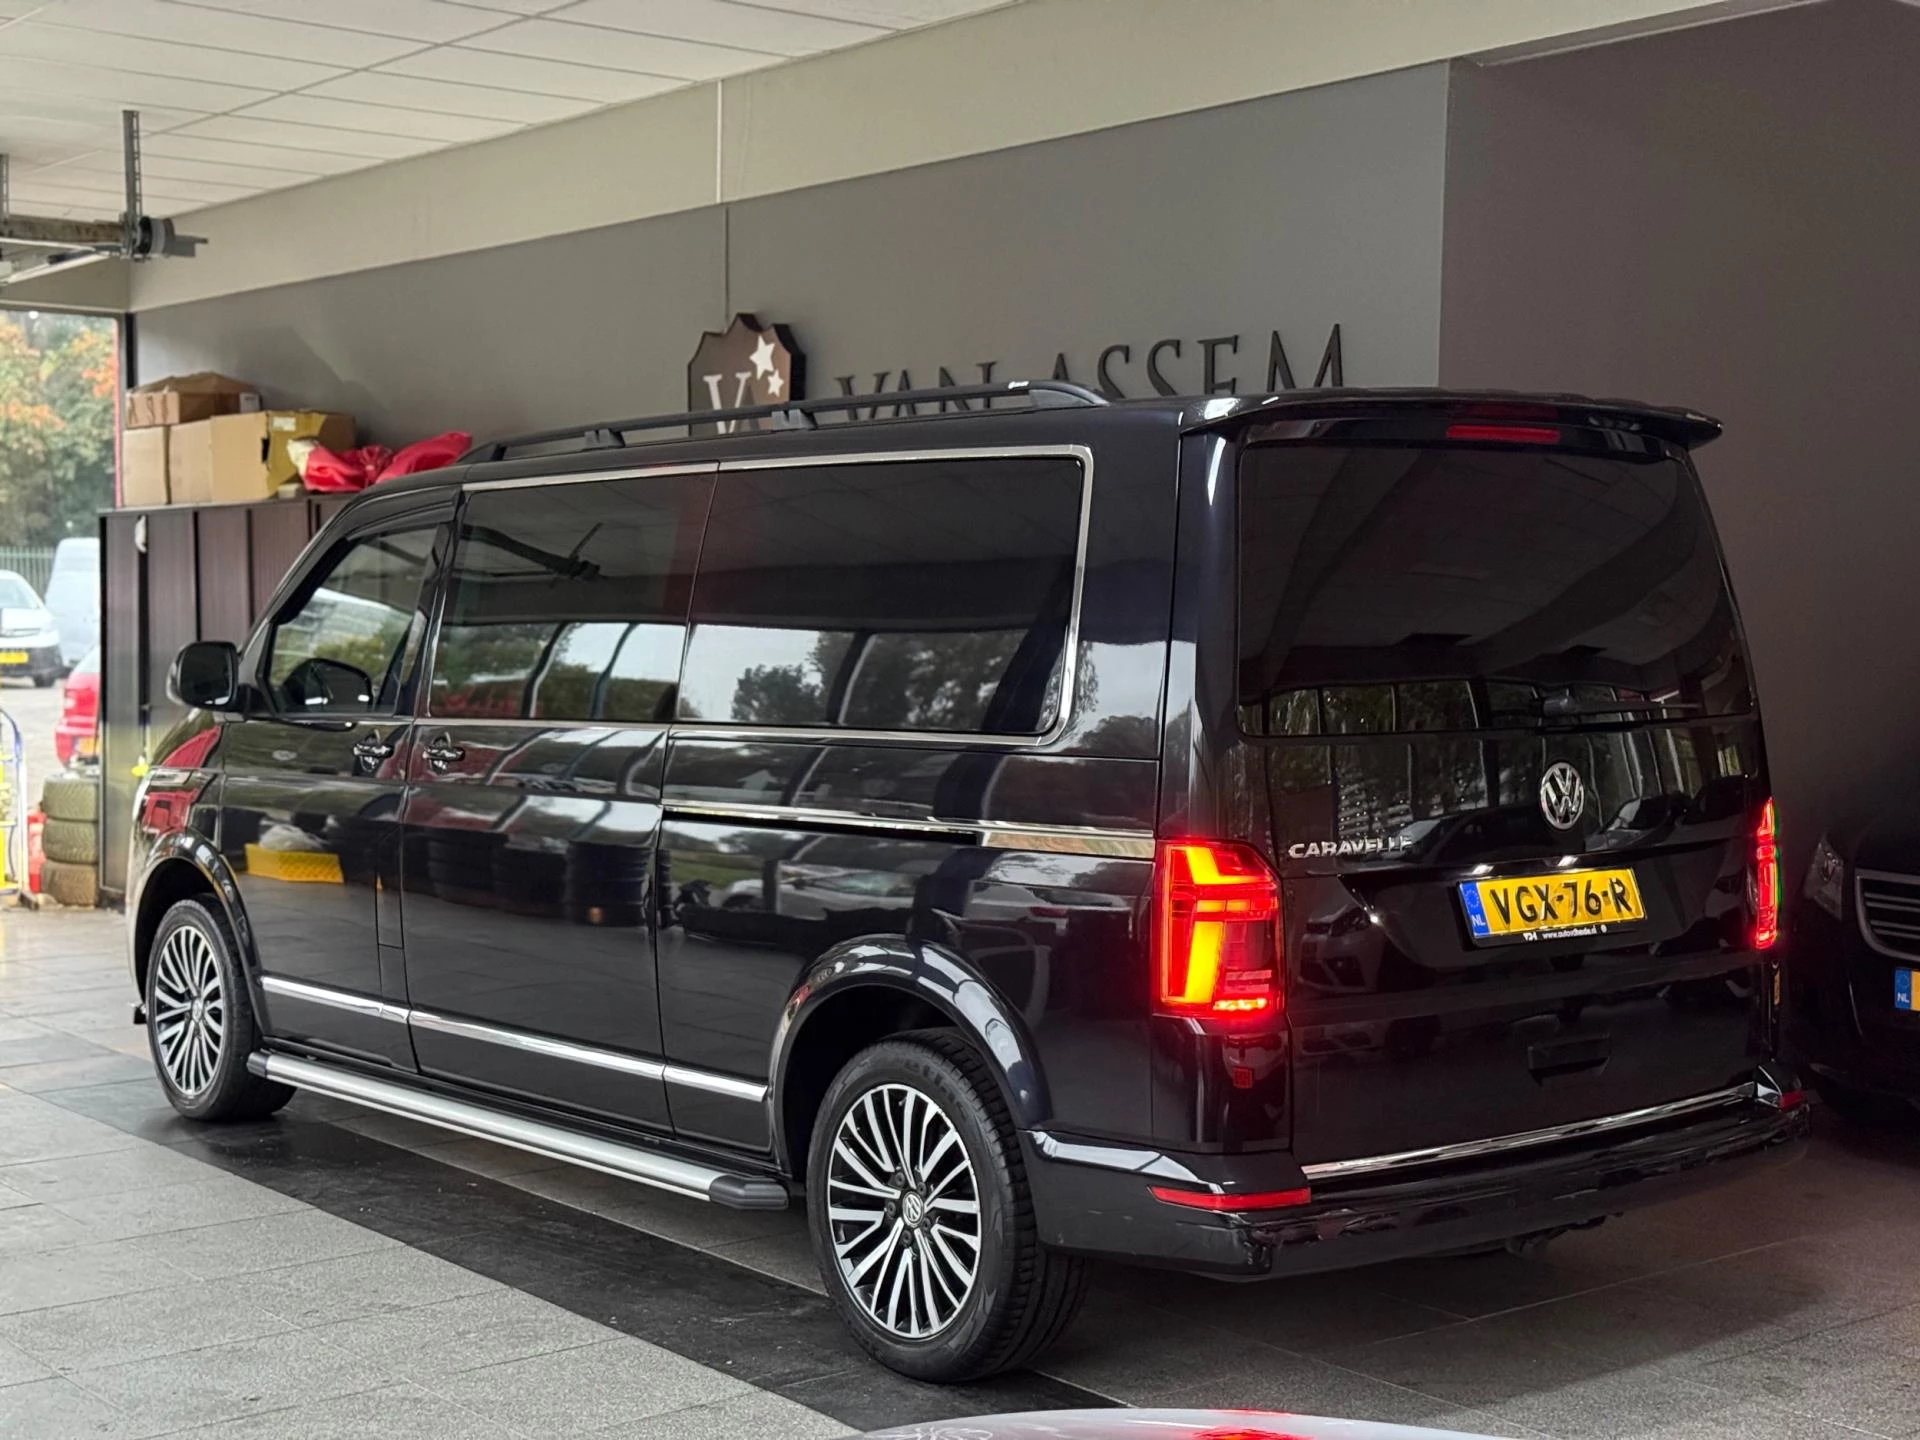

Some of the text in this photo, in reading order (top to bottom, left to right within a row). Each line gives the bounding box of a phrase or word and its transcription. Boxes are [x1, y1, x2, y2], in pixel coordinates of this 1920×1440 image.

[1288, 836, 1412, 858] CARAVELLE
[1490, 877, 1633, 925] VGX-76-R
[1471, 914, 1486, 927] NL
[1897, 992, 1909, 1003] NL
